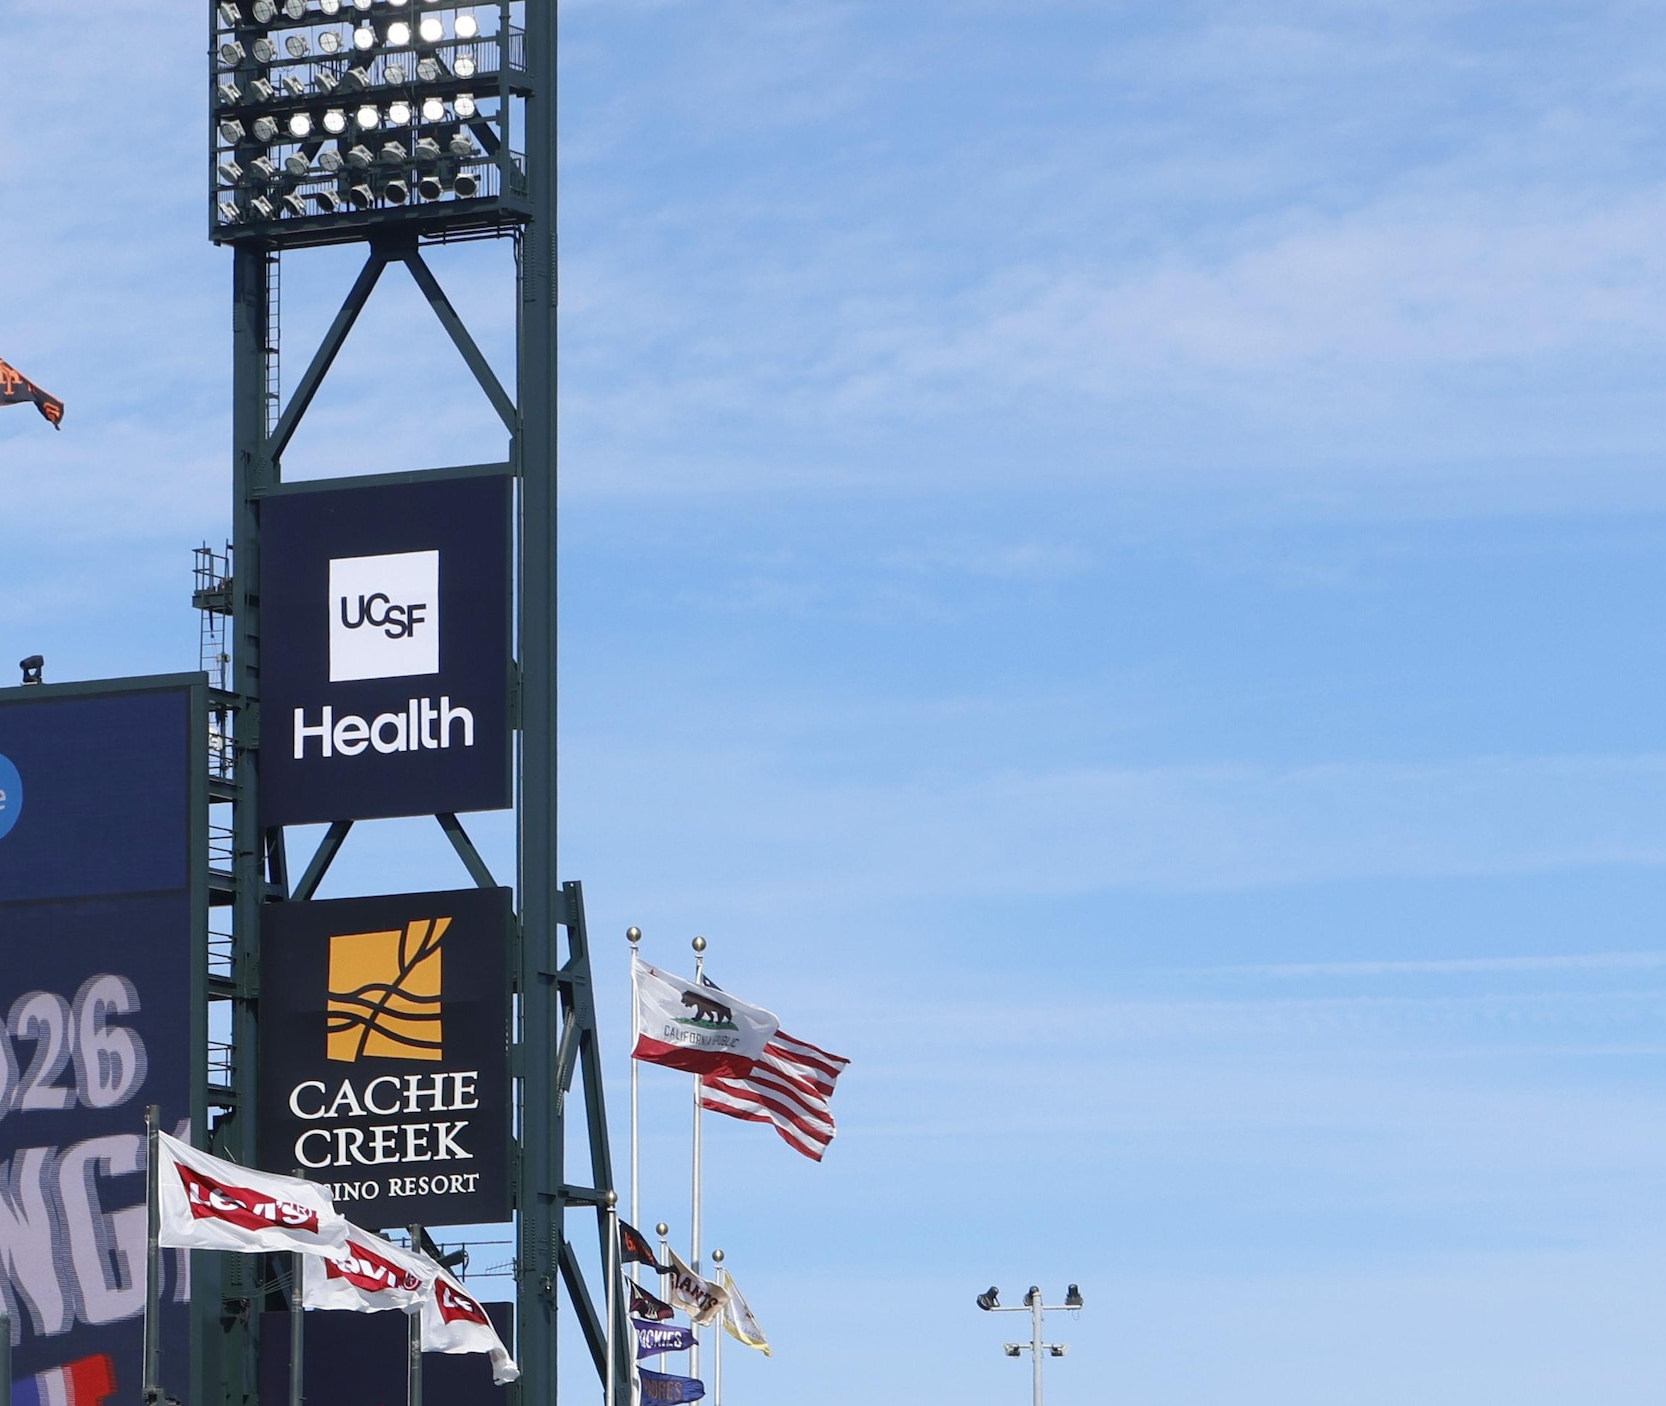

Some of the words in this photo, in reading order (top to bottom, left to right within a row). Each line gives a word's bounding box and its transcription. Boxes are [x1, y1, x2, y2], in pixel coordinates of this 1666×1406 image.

[339, 592, 427, 640] UCSF
[293, 695, 475, 760] Health
[289, 1071, 480, 1120] CACHE
[293, 1120, 475, 1168] CREEK
[388, 1173, 480, 1197] RESORT
